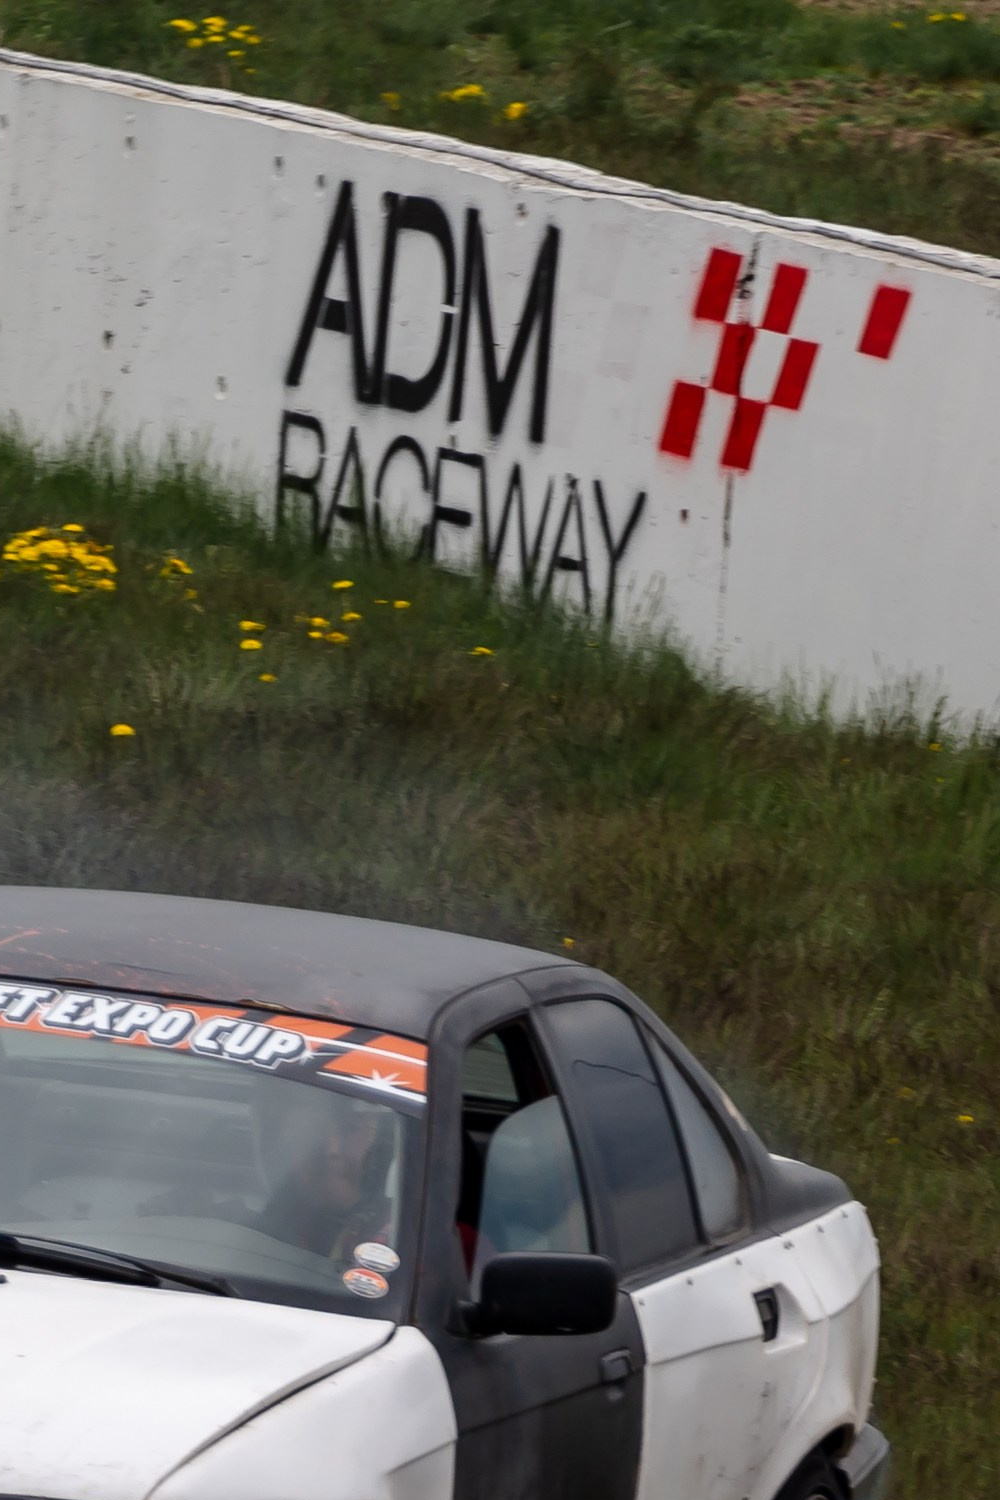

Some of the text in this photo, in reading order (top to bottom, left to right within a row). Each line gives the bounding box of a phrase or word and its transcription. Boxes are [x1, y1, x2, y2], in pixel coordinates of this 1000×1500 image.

[285, 180, 561, 445] ADM
[276, 409, 648, 623] RACEWAY
[46, 991, 194, 1041] EXPO
[194, 1017, 302, 1062] CUP
